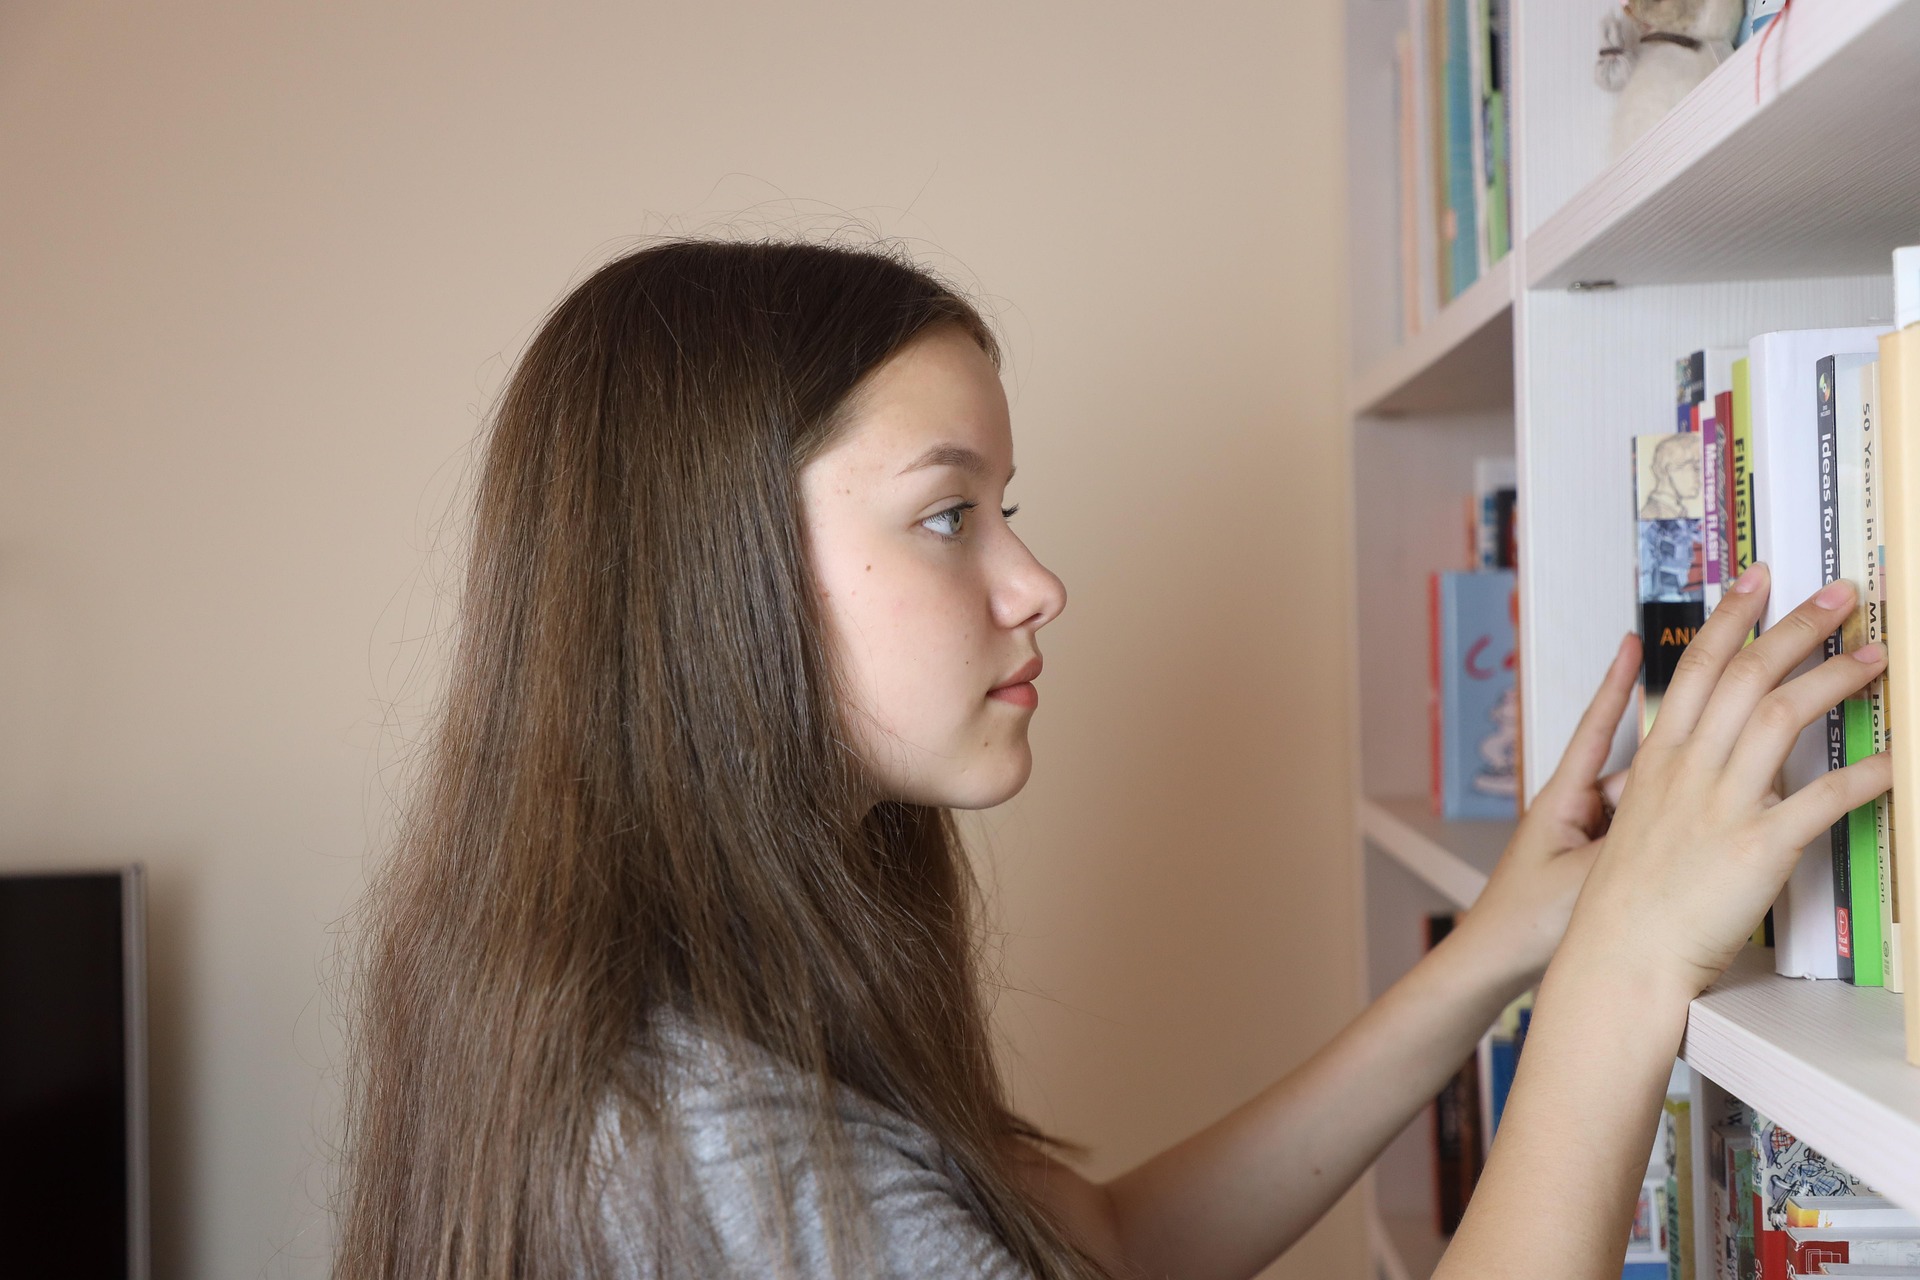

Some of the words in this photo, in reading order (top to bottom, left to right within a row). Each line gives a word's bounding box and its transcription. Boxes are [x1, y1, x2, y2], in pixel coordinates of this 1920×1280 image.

[1863, 403, 1871, 432] 50
[1821, 433, 1831, 502] Ideas
[1864, 440, 1872, 509] Years
[1735, 438, 1747, 541] FINISH
[1823, 506, 1834, 543] for
[1866, 518, 1874, 541] in
[1824, 547, 1835, 584] the
[1867, 550, 1875, 592] the
[1660, 626, 1699, 646] ANI
[1869, 602, 1877, 640] Mo
[1872, 694, 1880, 754] Hous
[1830, 726, 1841, 770] Sho
[1878, 845, 1886, 904] Larson
[1714, 1191, 1724, 1280] CREATIV
